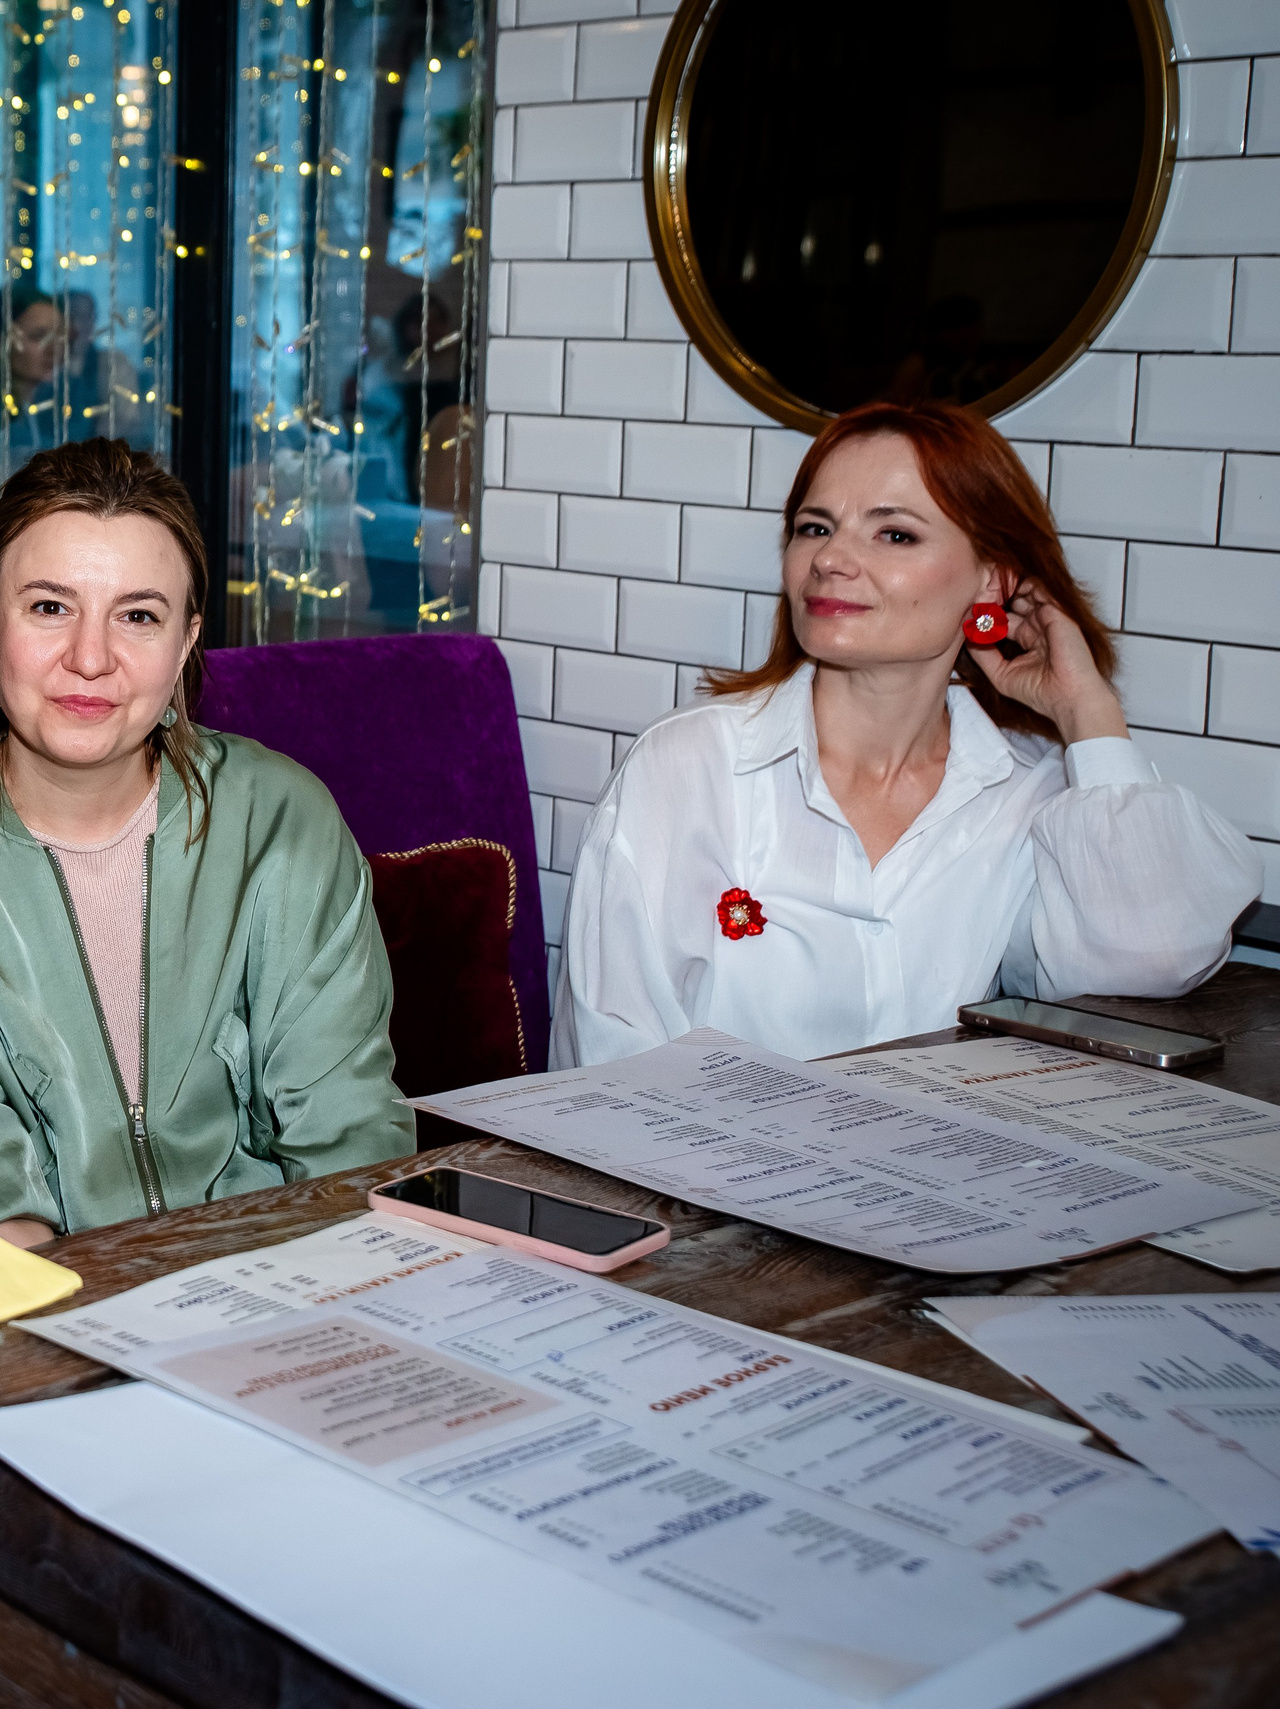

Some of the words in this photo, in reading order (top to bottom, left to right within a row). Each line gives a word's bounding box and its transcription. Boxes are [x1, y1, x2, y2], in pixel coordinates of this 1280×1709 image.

[1030, 1060, 1100, 1074] КРЕПКИЕ
[711, 1355, 791, 1387] БАРНОЕ
[645, 1385, 715, 1413] МЕНЮ
